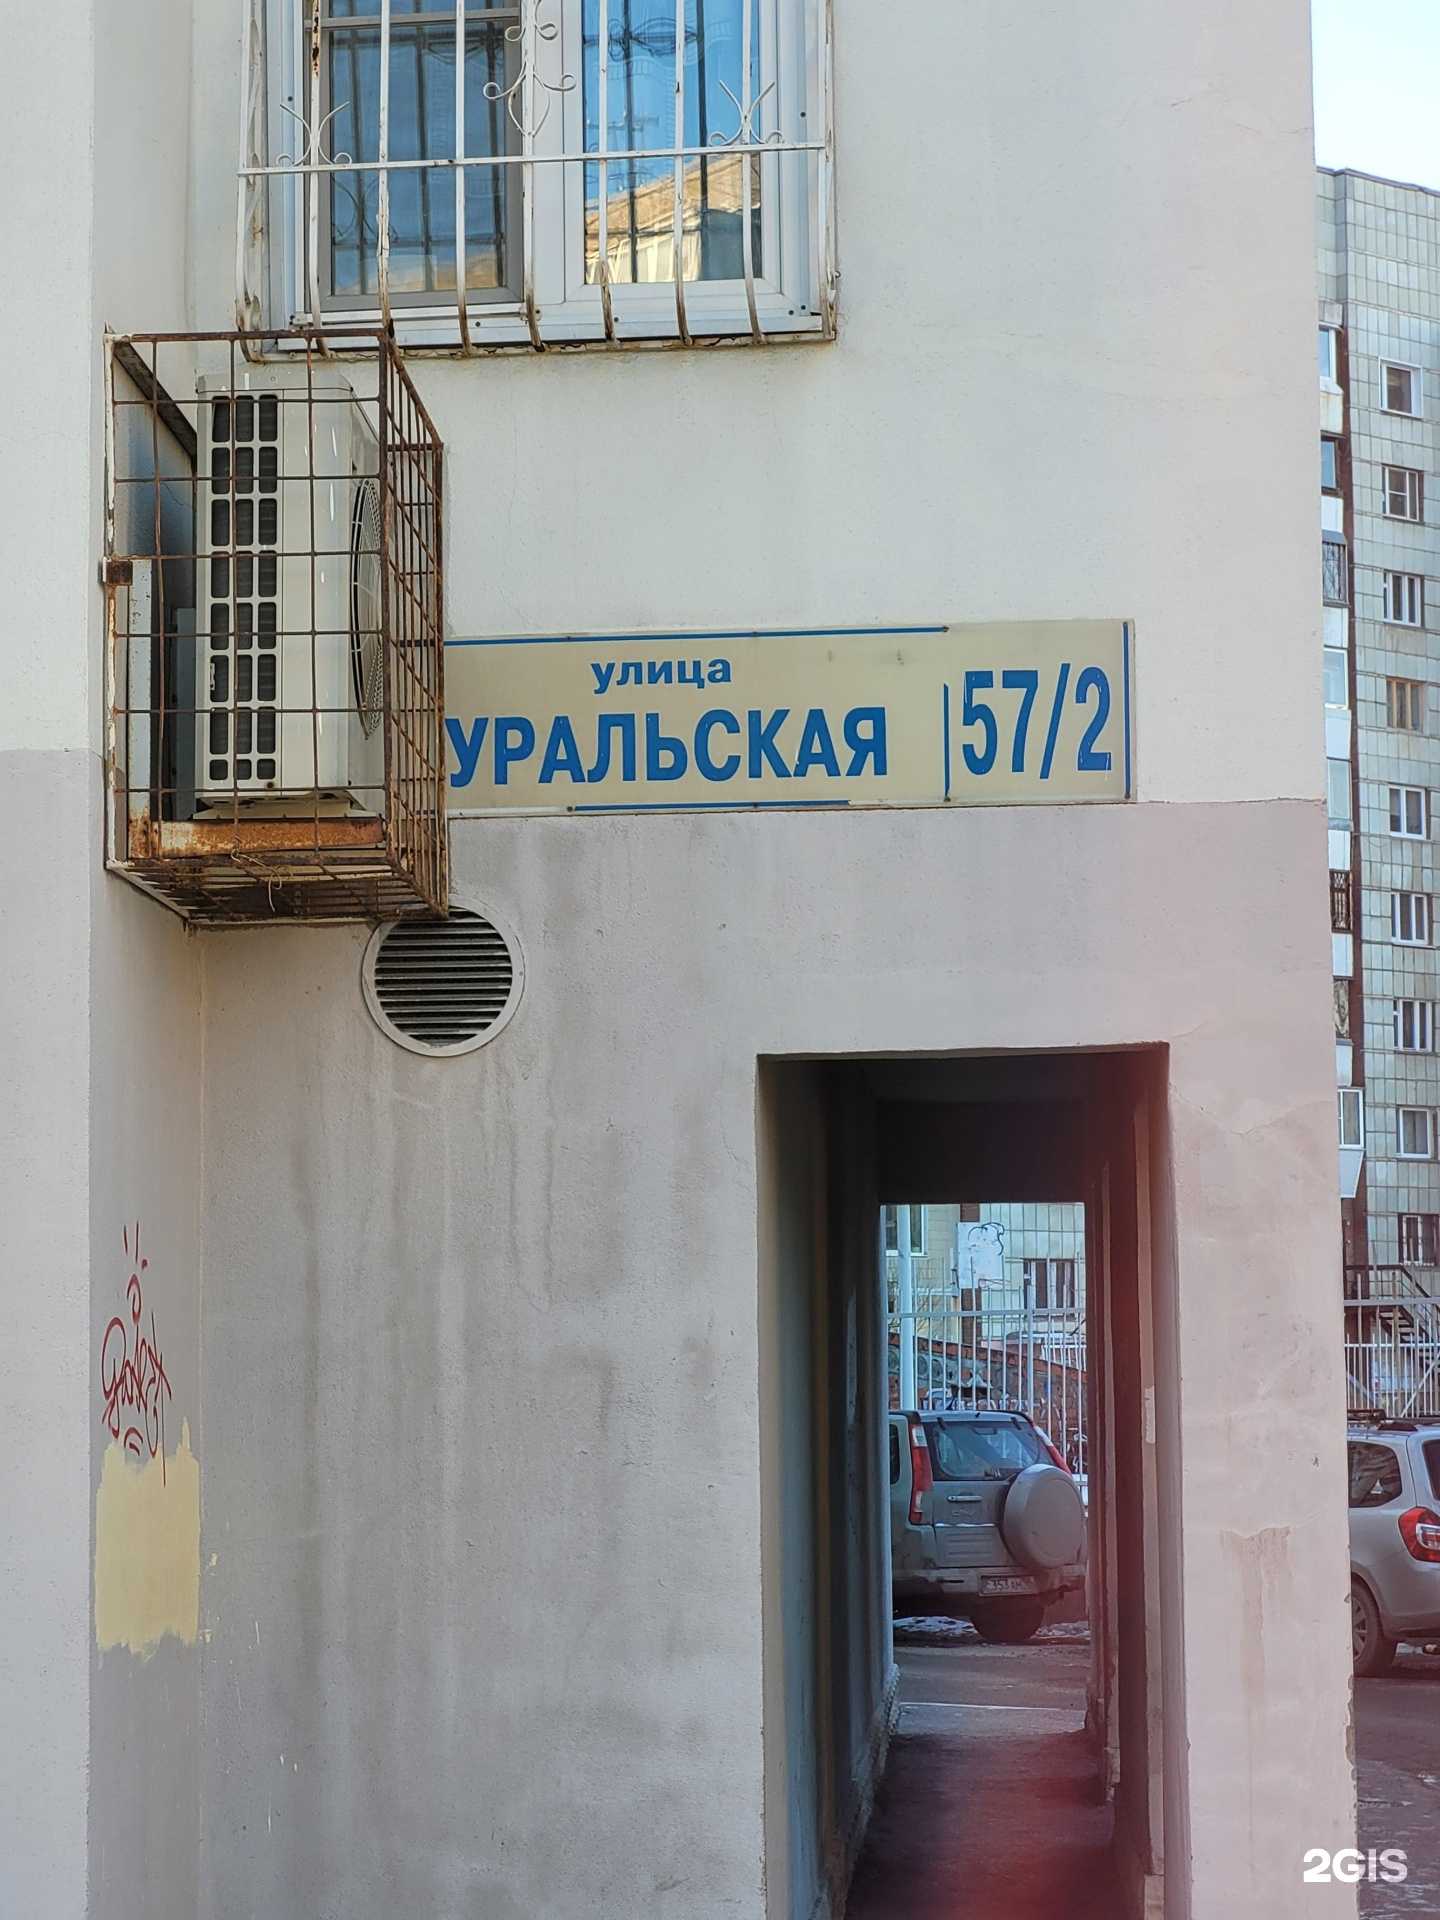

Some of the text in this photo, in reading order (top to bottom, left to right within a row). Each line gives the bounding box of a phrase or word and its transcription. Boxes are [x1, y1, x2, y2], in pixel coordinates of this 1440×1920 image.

[592, 658, 732, 694] улица
[445, 706, 888, 788] УРАЛЬСКАЯ
[961, 663, 1112, 780] 57/2
